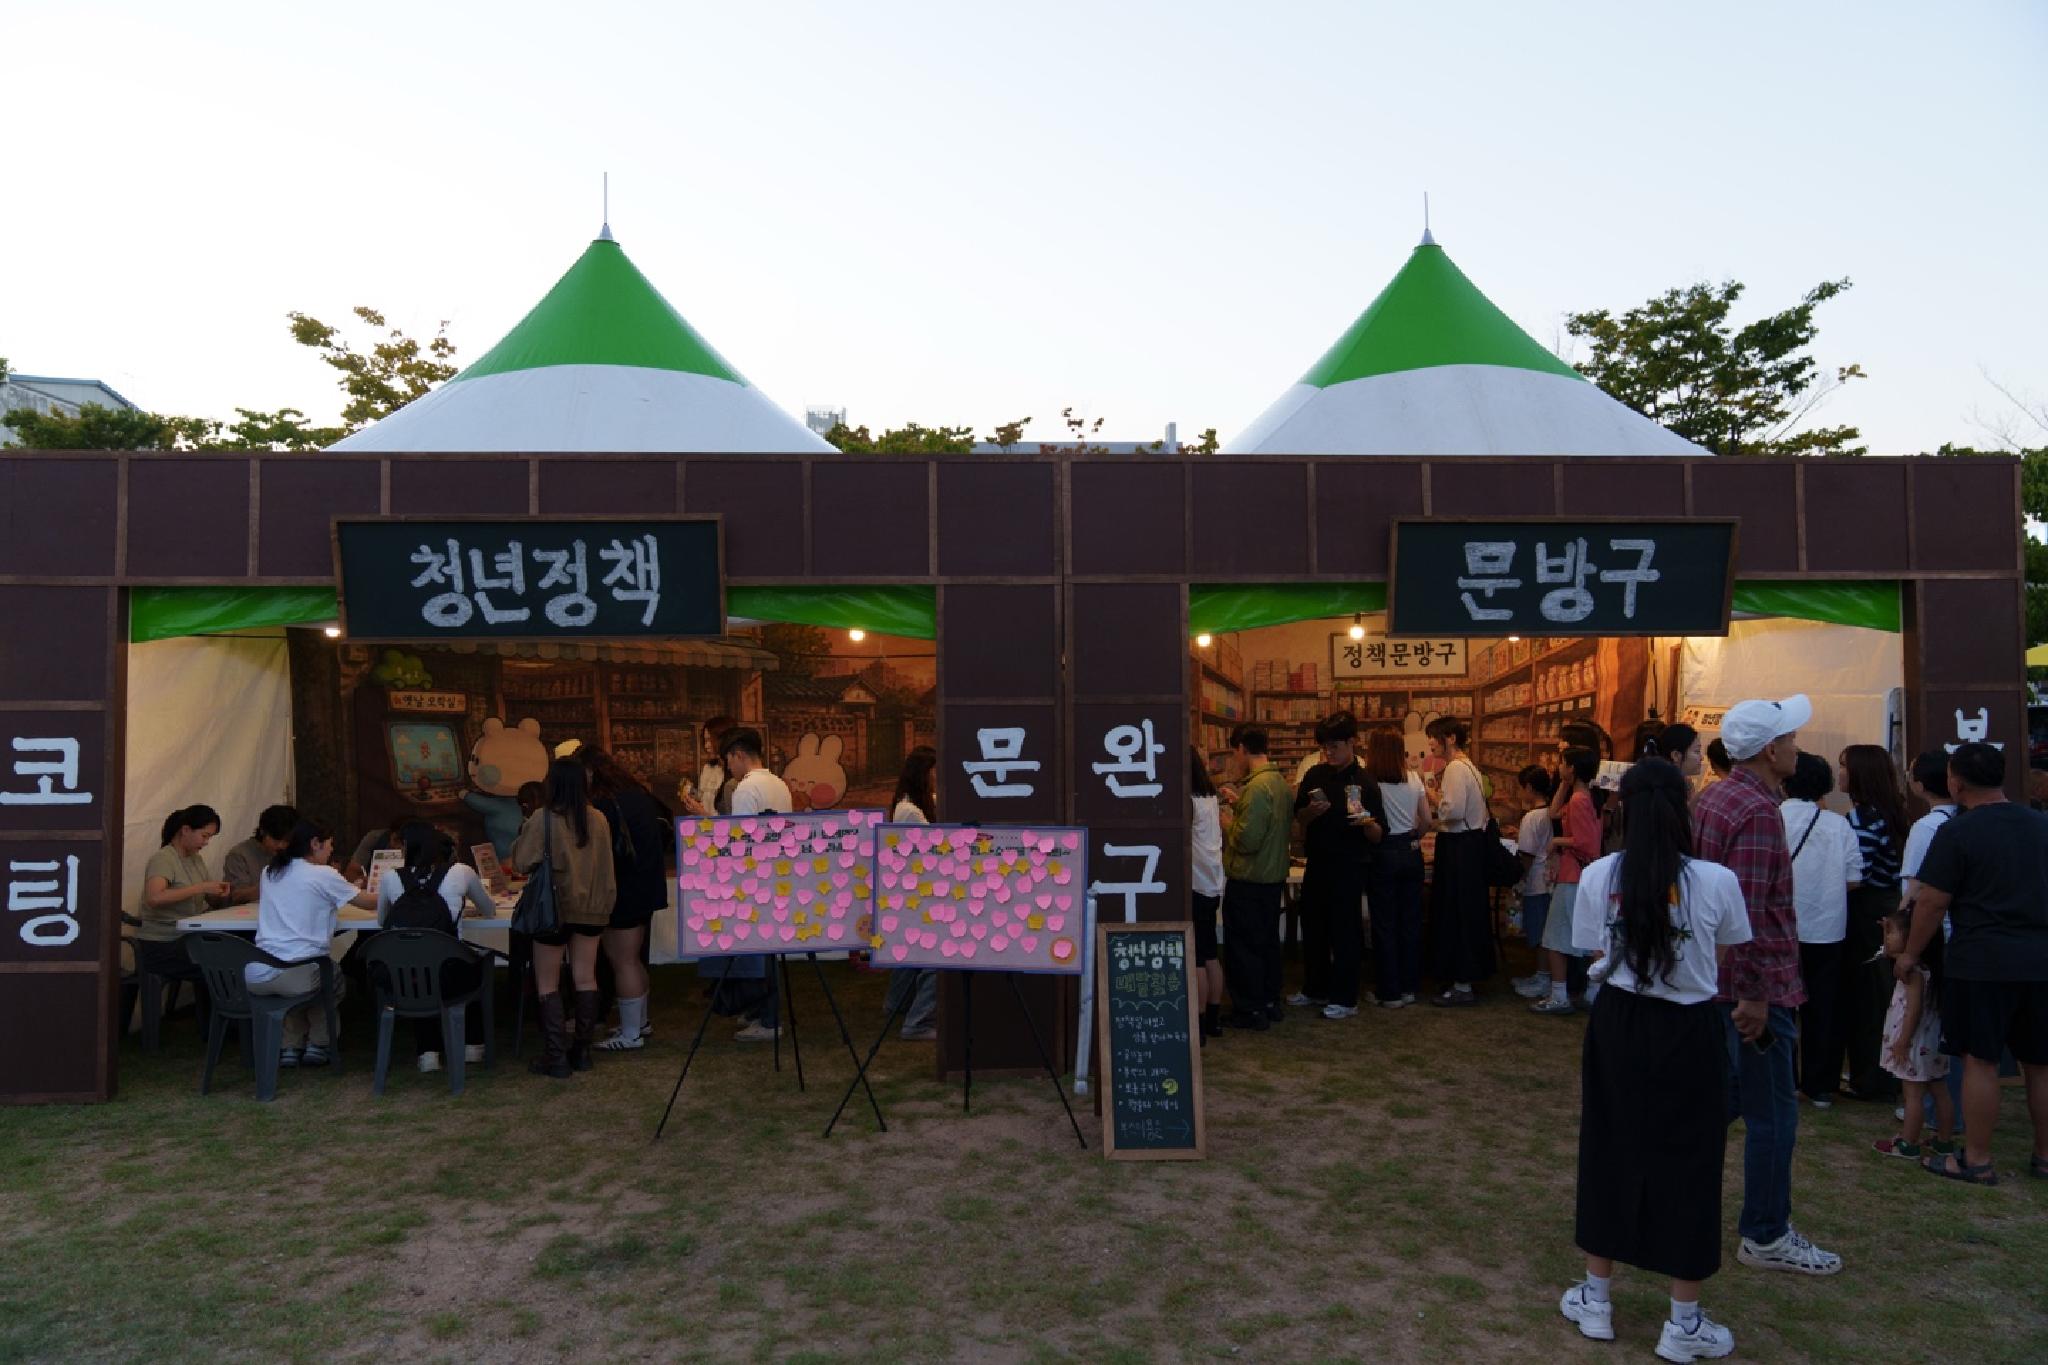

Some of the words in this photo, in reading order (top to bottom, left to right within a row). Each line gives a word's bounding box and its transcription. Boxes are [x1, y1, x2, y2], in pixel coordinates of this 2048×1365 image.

[409, 533, 662, 628] 청년정책
[1456, 537, 1661, 623] 문방구
[1343, 641, 1456, 669] 정책문방구
[1113, 939, 1184, 970] 청년정책
